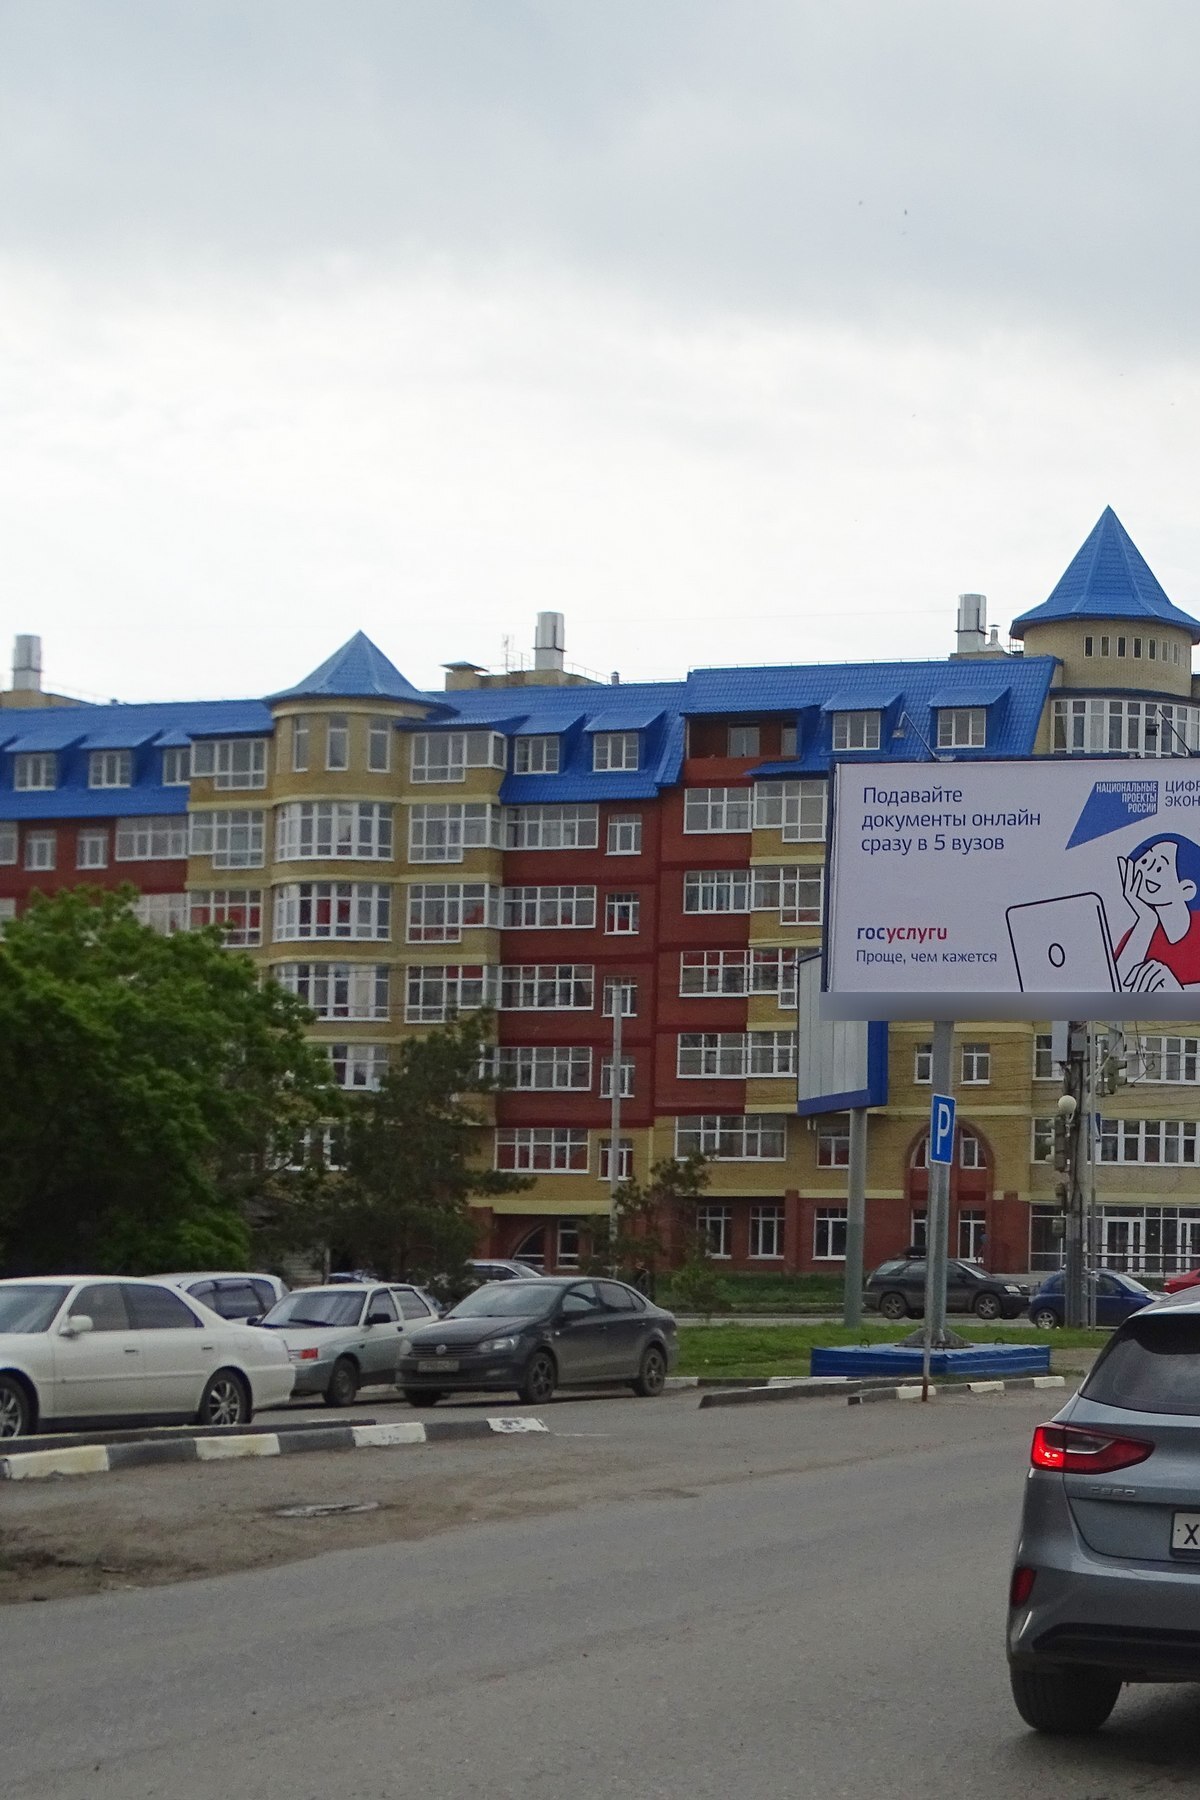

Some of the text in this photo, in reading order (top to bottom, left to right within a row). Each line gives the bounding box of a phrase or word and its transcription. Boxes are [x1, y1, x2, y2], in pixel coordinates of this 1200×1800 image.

[863, 786, 963, 806] Подавайте
[1096, 782, 1158, 793] НАЦИОНАЛЬНЫЕ
[1121, 793, 1157, 803] ПРОЕКТЫ
[1127, 803, 1157, 813] РОССИИ
[862, 809, 1041, 832] документы онлайн
[861, 834, 1005, 856] сразу в 5 вузов
[857, 927, 947, 944] госуслуги
[856, 949, 998, 965] Проще, чем кажется
[936, 1103, 951, 1155] P
